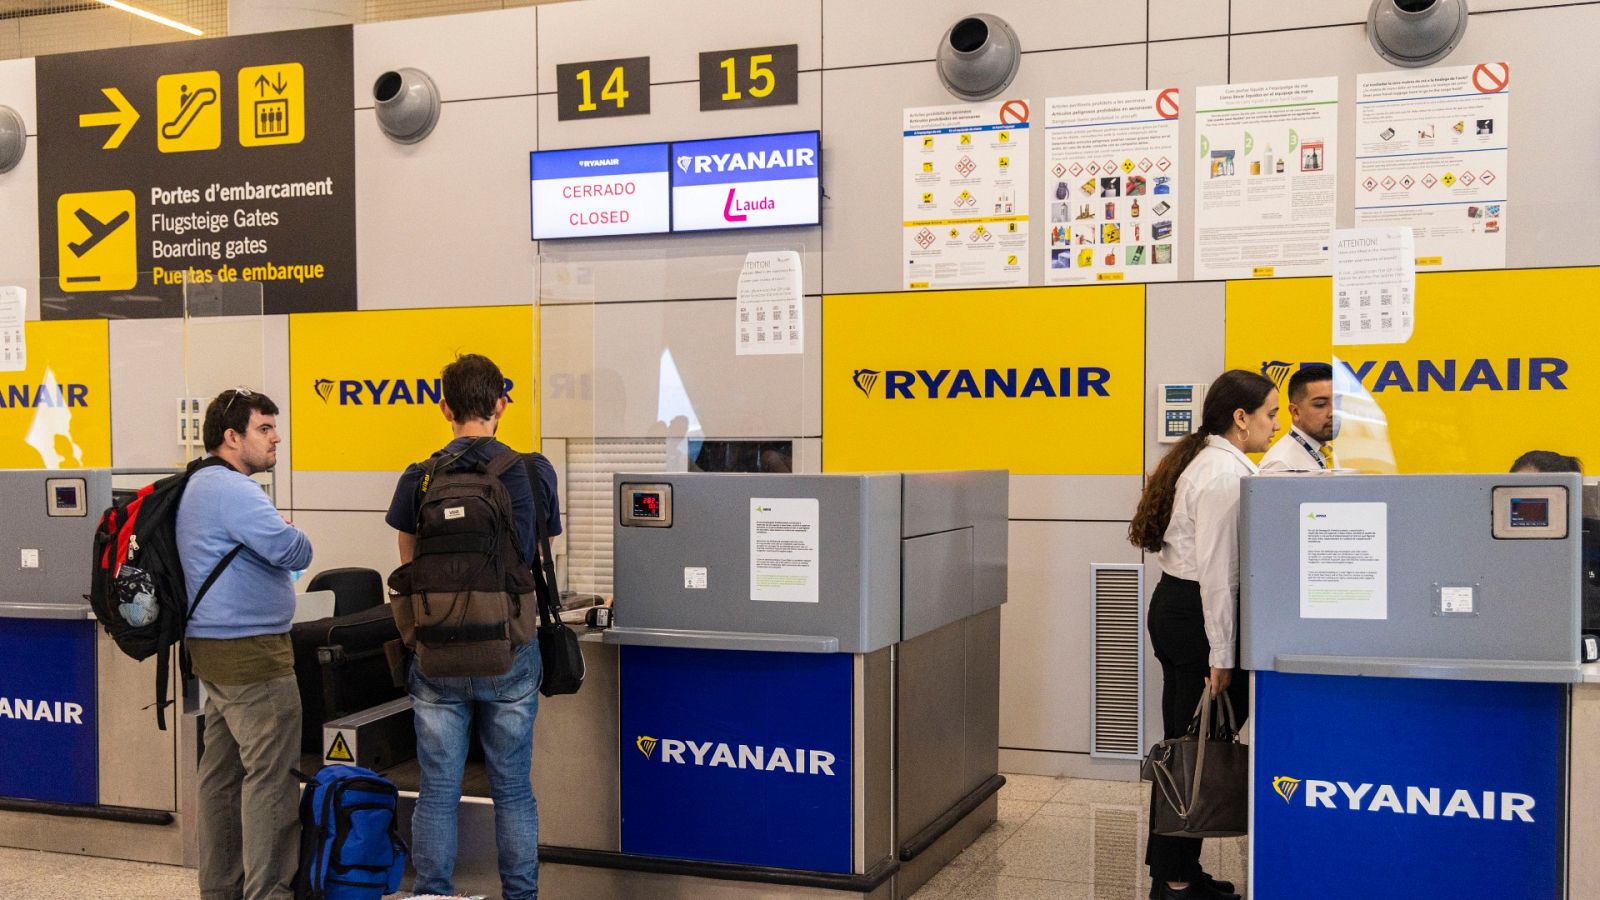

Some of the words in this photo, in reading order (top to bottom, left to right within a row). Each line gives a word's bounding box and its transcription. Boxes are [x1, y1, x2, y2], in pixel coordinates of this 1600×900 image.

[576, 67, 629, 111] 14
[720, 54, 776, 101] 15
[584, 158, 619, 167] RYANAIR
[694, 148, 814, 174] RYANAIR
[151, 187, 200, 205] Portes
[205, 177, 333, 202] d'embarcament
[563, 182, 635, 199] CERRADO
[736, 196, 775, 211] Lauda
[152, 211, 229, 235] Flugsteige
[233, 209, 279, 228] Gates
[570, 210, 629, 225] CLOSED
[152, 239, 221, 260] Boarding
[225, 237, 268, 259] gates
[218, 264, 237, 282] de
[242, 262, 324, 283] embarque
[885, 367, 1111, 399] RYANAIR
[1300, 357, 1568, 392] YANAIR
[661, 738, 835, 776] RYANAIR
[1305, 779, 1535, 823] RYANAIR
